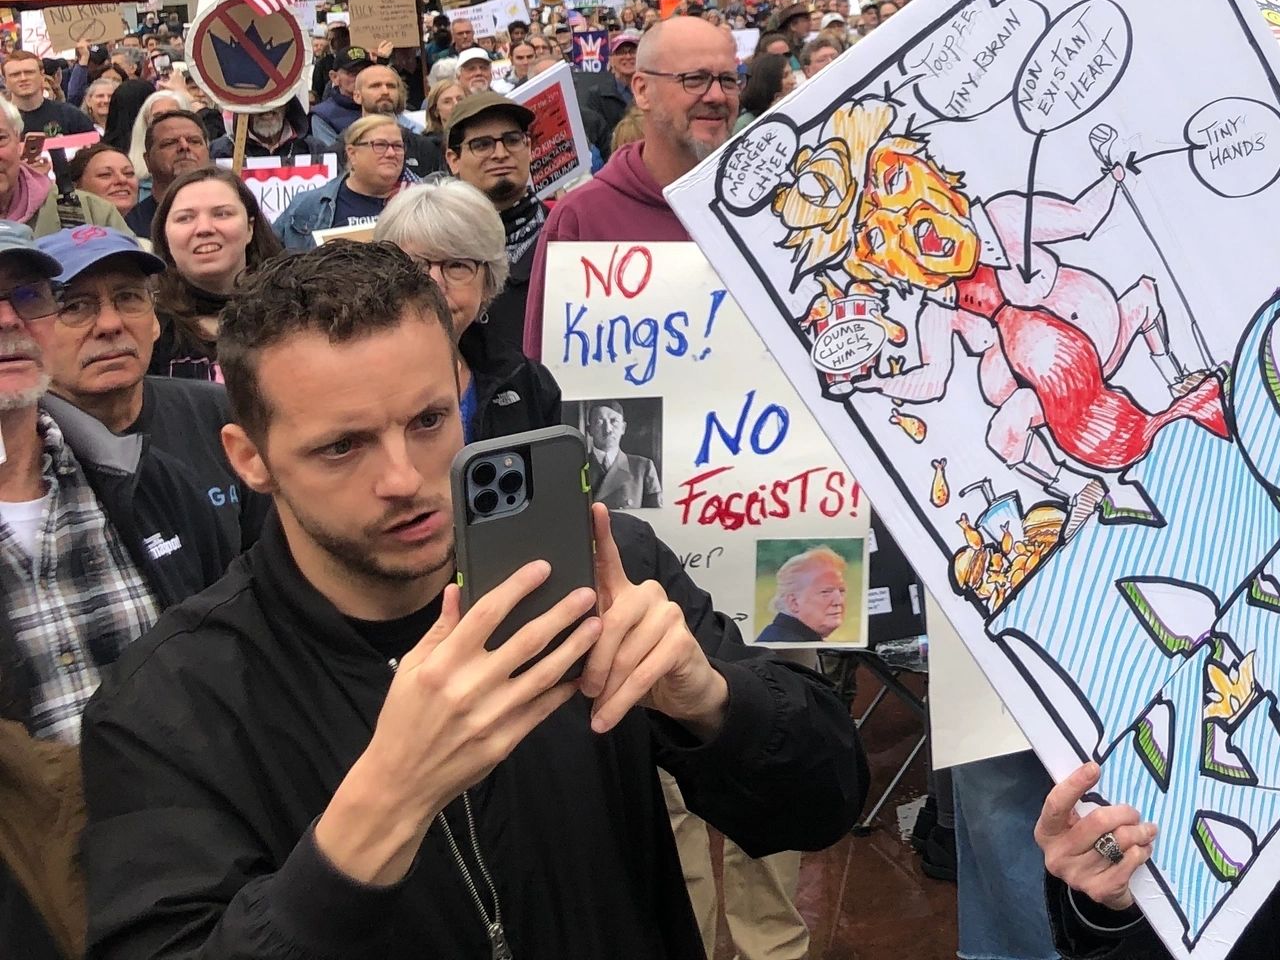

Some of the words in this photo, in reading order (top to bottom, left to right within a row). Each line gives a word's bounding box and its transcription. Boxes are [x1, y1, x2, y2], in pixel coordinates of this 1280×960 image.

[582, 59, 602, 73] NO
[910, 8, 980, 78] TOUPEE
[945, 72, 980, 116] TINY
[972, 7, 1021, 74] BRAIN
[1037, 5, 1093, 116] EXISTANT
[1064, 26, 1118, 110] HEART
[1018, 59, 1044, 112] NON
[1197, 115, 1242, 146] TINY
[1208, 136, 1266, 170] HANDS
[535, 178, 550, 192] NO
[724, 137, 755, 182] FEAR
[728, 130, 778, 198] MONGER
[747, 141, 790, 202] CHIEF
[753, 158, 768, 177] IN
[581, 245, 653, 299] NO
[562, 289, 727, 385] Kings!
[819, 333, 870, 360] CLUCK
[823, 323, 865, 347] DUMB
[832, 348, 856, 368] HIM
[692, 389, 791, 467] NO
